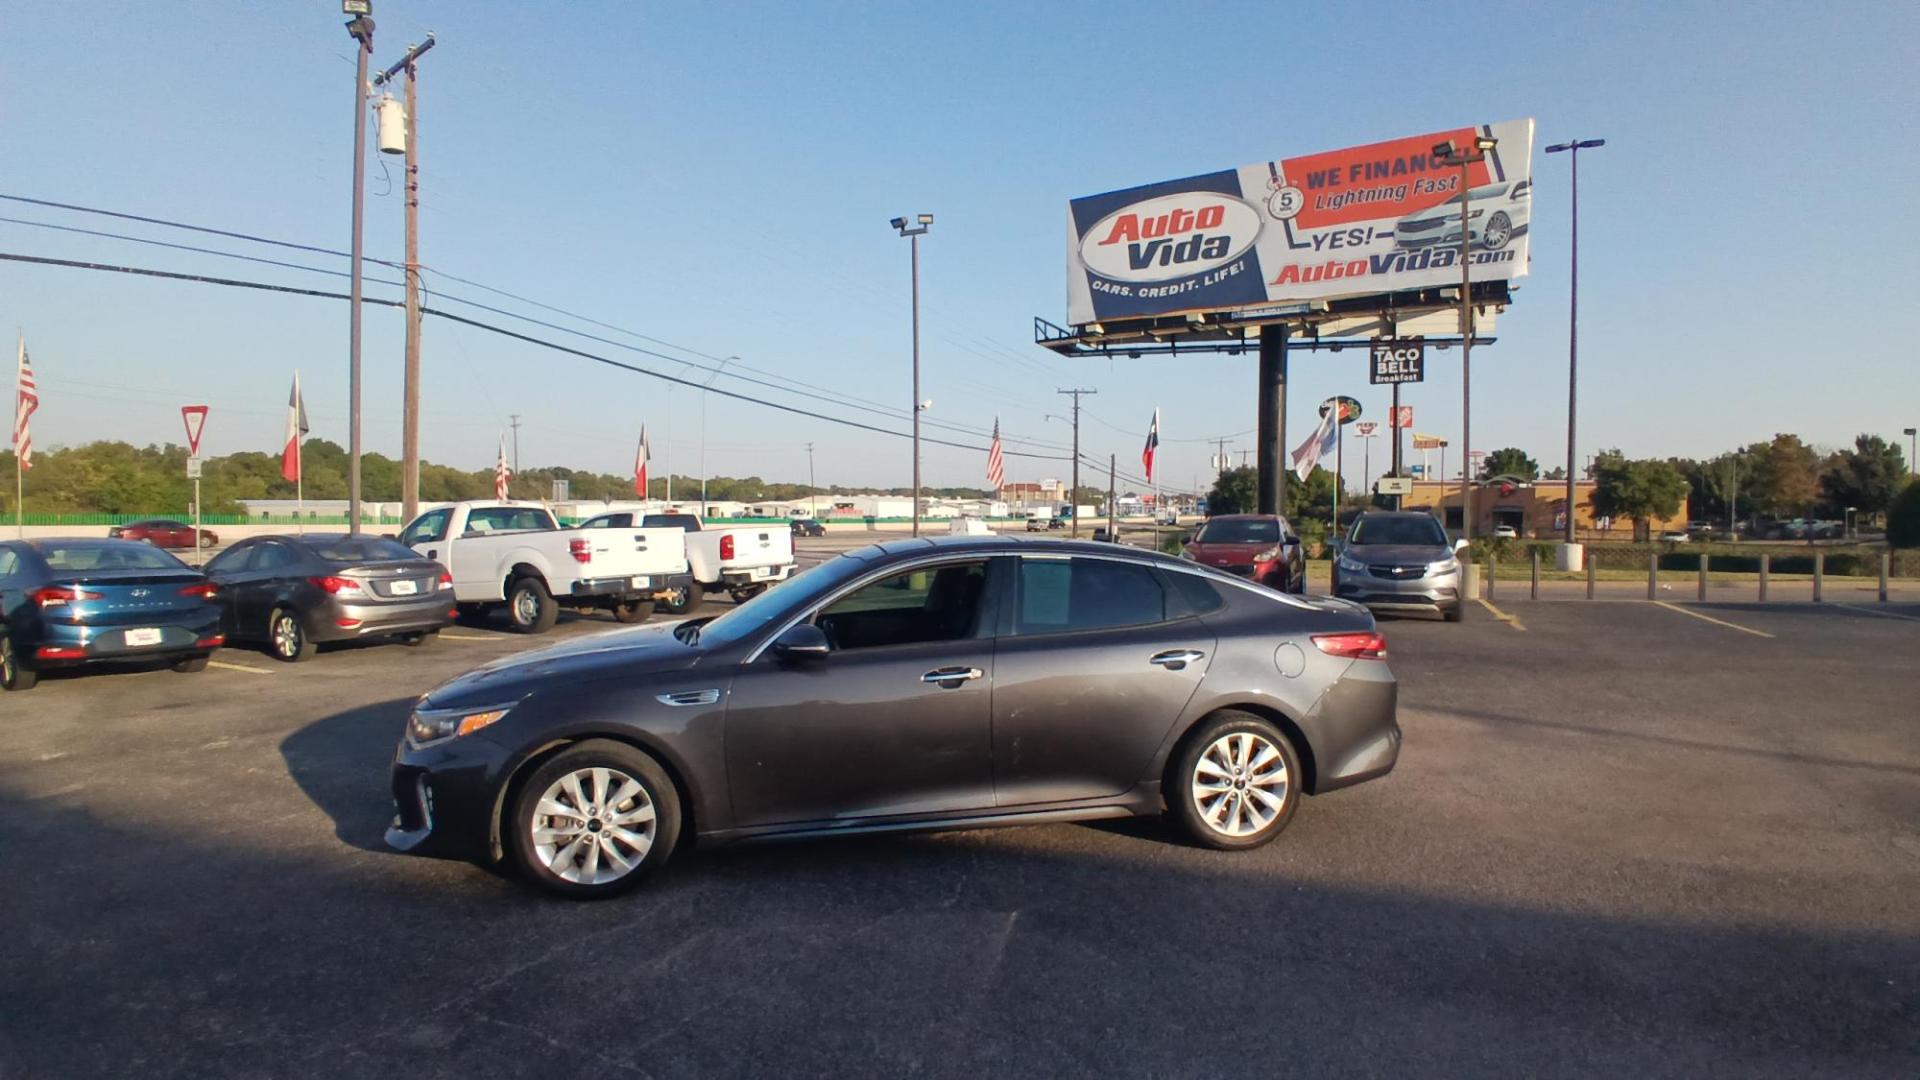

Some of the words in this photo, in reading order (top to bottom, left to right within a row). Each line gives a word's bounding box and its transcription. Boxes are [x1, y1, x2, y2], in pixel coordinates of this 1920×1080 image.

[1306, 168, 1341, 190] WE
[1280, 192, 1292, 206] 5
[1315, 185, 1407, 210] Lightning
[1414, 175, 1458, 195] Fast
[1098, 205, 1226, 246] Auto
[1312, 226, 1373, 251] YES!
[1127, 234, 1231, 270] Vida
[1092, 280, 1134, 297] CARS.
[1138, 279, 1200, 298] CREDIT.
[1203, 260, 1246, 286] LIFE!
[1374, 349, 1420, 362] TACO
[1375, 374, 1418, 383] Breakfast
[1377, 361, 1419, 374] BELL
